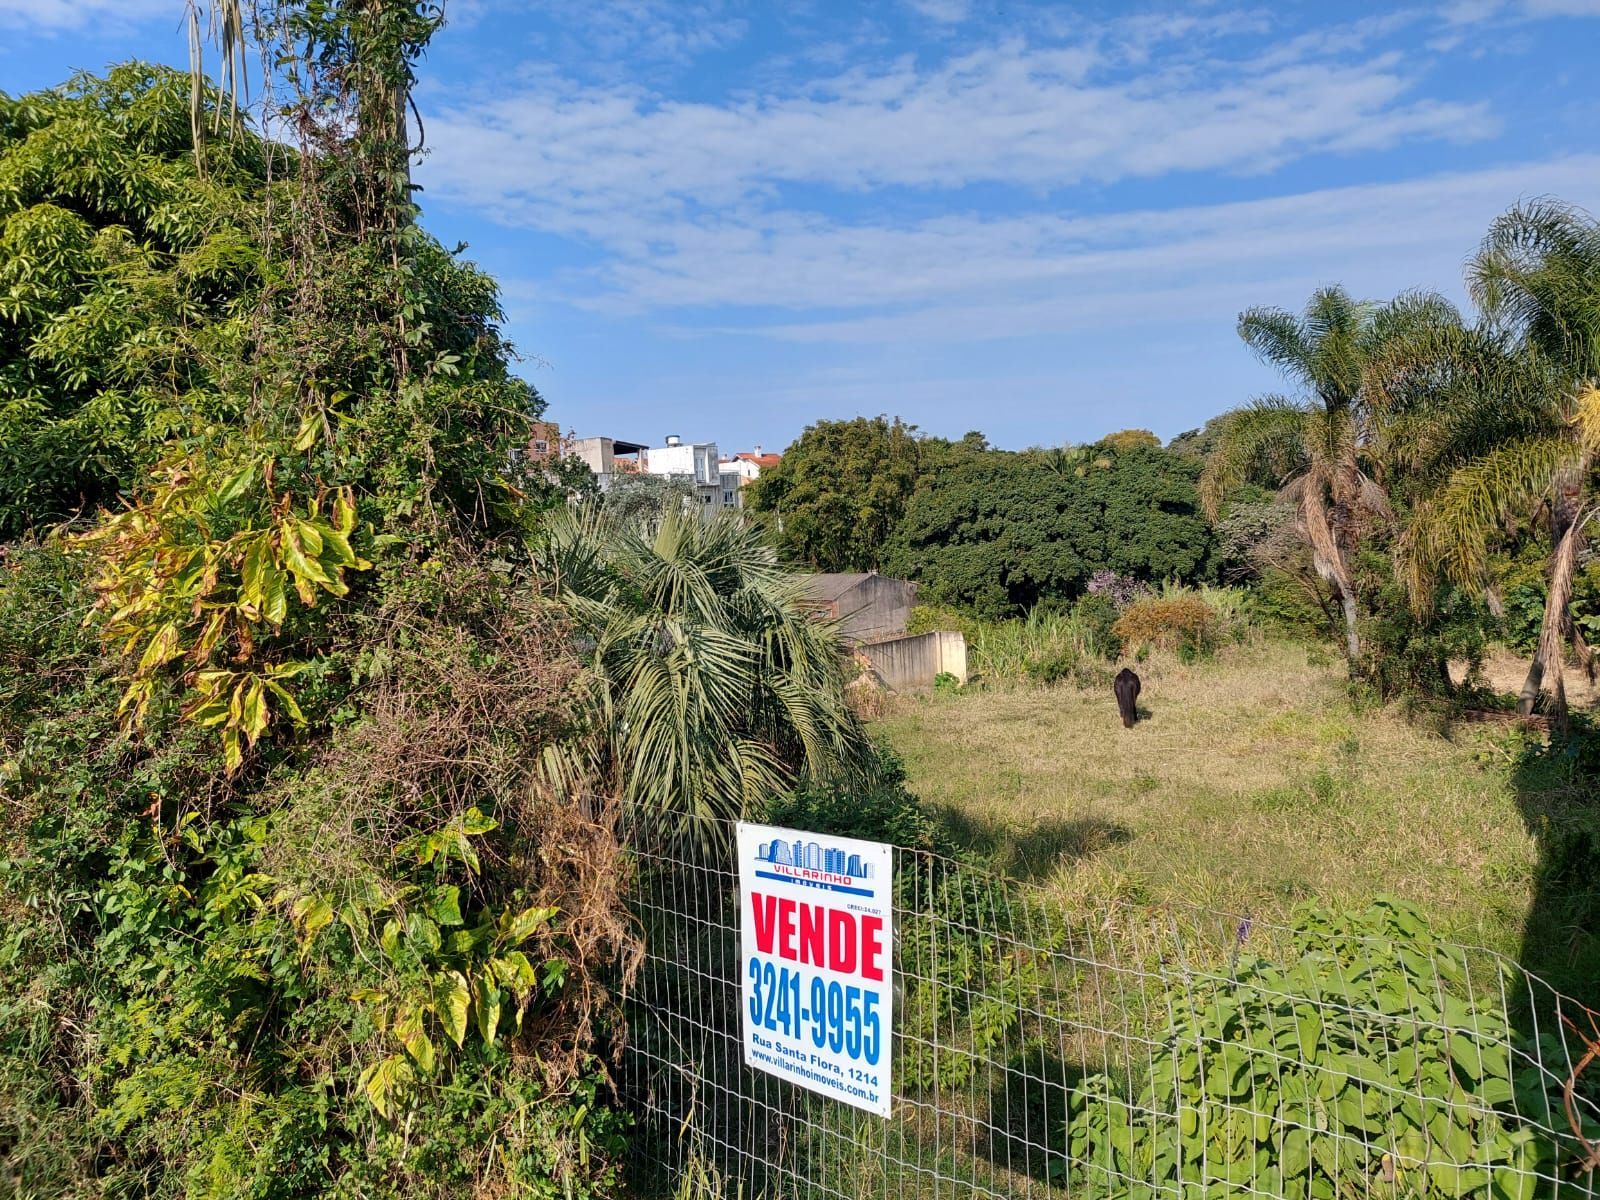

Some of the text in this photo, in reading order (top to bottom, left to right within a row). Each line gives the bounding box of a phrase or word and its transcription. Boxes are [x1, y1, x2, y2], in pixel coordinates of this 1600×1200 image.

[774, 864, 852, 885] VILLARINHO
[751, 891, 883, 982] VENDE
[749, 957, 880, 1066] 3241-9955
[751, 1048, 879, 1103] www.villarinhoimoveis.com.br
[752, 1033, 878, 1087] Rua Santa Flora, 1214
